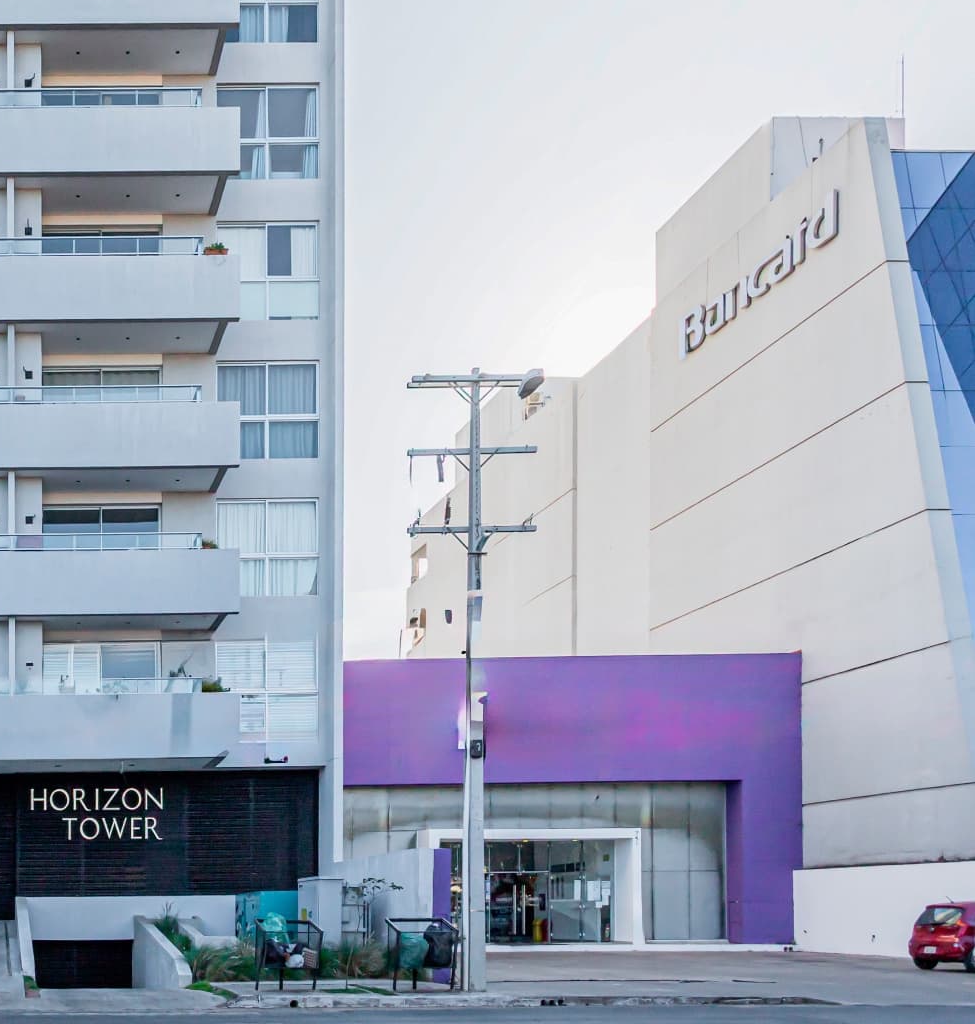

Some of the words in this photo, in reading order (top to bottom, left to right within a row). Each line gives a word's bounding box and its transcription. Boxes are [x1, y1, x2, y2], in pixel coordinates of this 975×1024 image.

[679, 188, 840, 361] Bancard
[29, 787, 164, 812] HORIZON
[61, 817, 163, 841] TOWER
